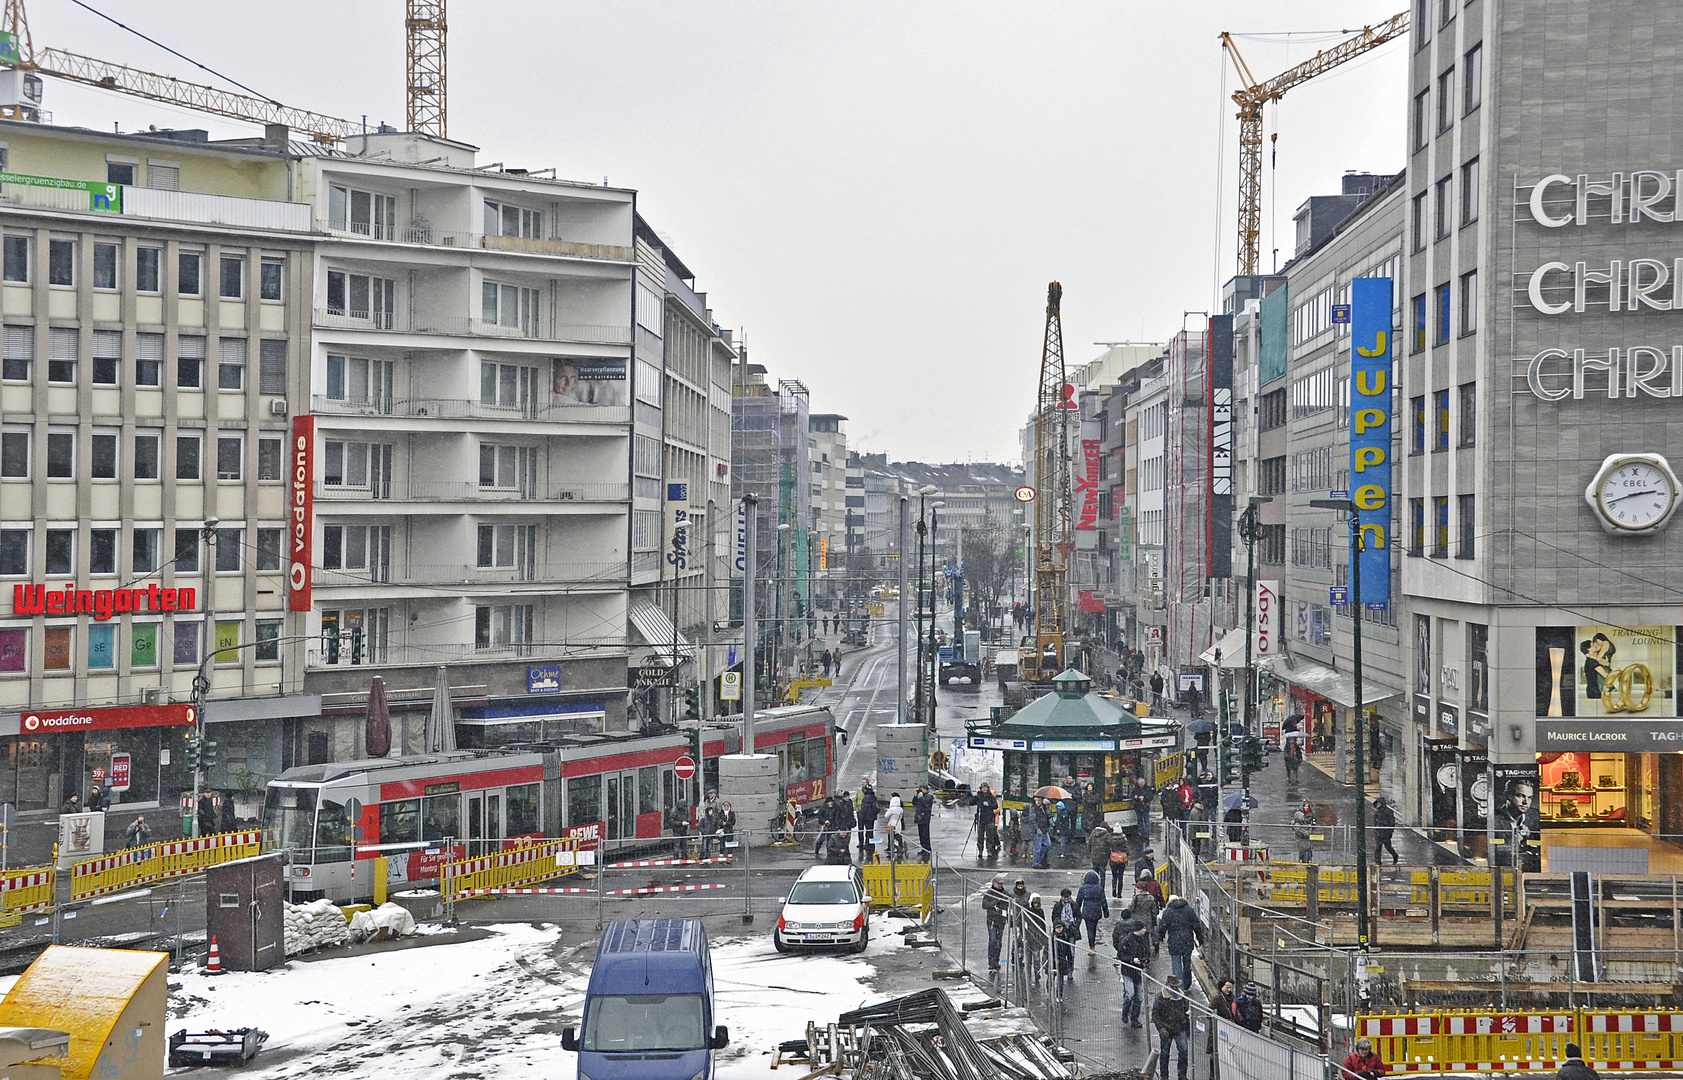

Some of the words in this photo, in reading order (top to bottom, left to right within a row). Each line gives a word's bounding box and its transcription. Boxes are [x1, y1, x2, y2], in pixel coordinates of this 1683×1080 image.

[294, 435, 306, 552] vodafone
[1018, 490, 1032, 498] C&A
[13, 584, 196, 621] Weingarten
[1259, 583, 1276, 652] orsay
[1632, 637, 1670, 645] LOUNGE
[42, 715, 92, 726] vodafone
[1547, 731, 1587, 741] MAURICE
[1589, 731, 1627, 741] LACROIX
[113, 764, 128, 772] RED
[570, 824, 599, 841] REWE
